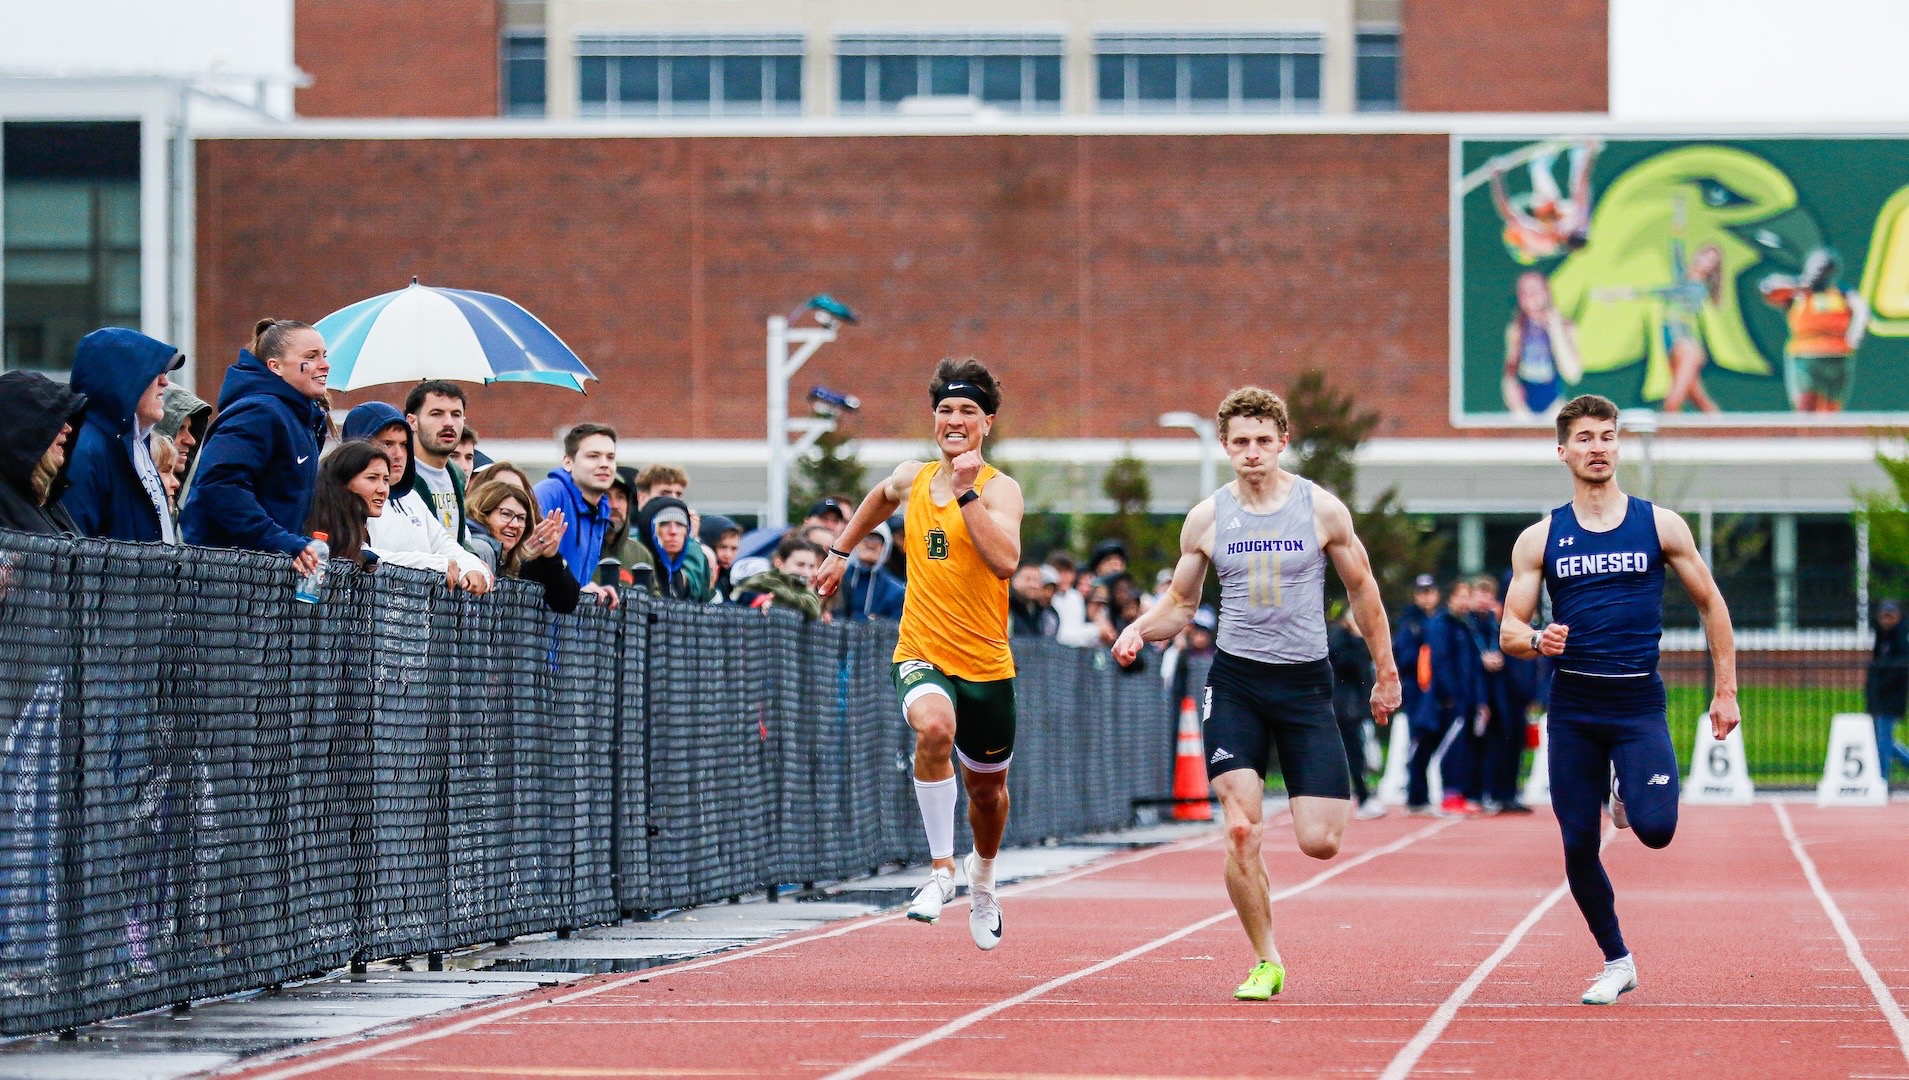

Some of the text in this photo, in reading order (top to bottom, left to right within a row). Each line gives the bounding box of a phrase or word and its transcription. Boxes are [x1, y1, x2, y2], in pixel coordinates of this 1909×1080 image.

[926, 528, 949, 560] B
[1226, 539, 1305, 555] HOUGHTON
[1556, 552, 1648, 579] GENESEO
[1707, 744, 1731, 778] 6
[1842, 744, 1864, 779] 5
